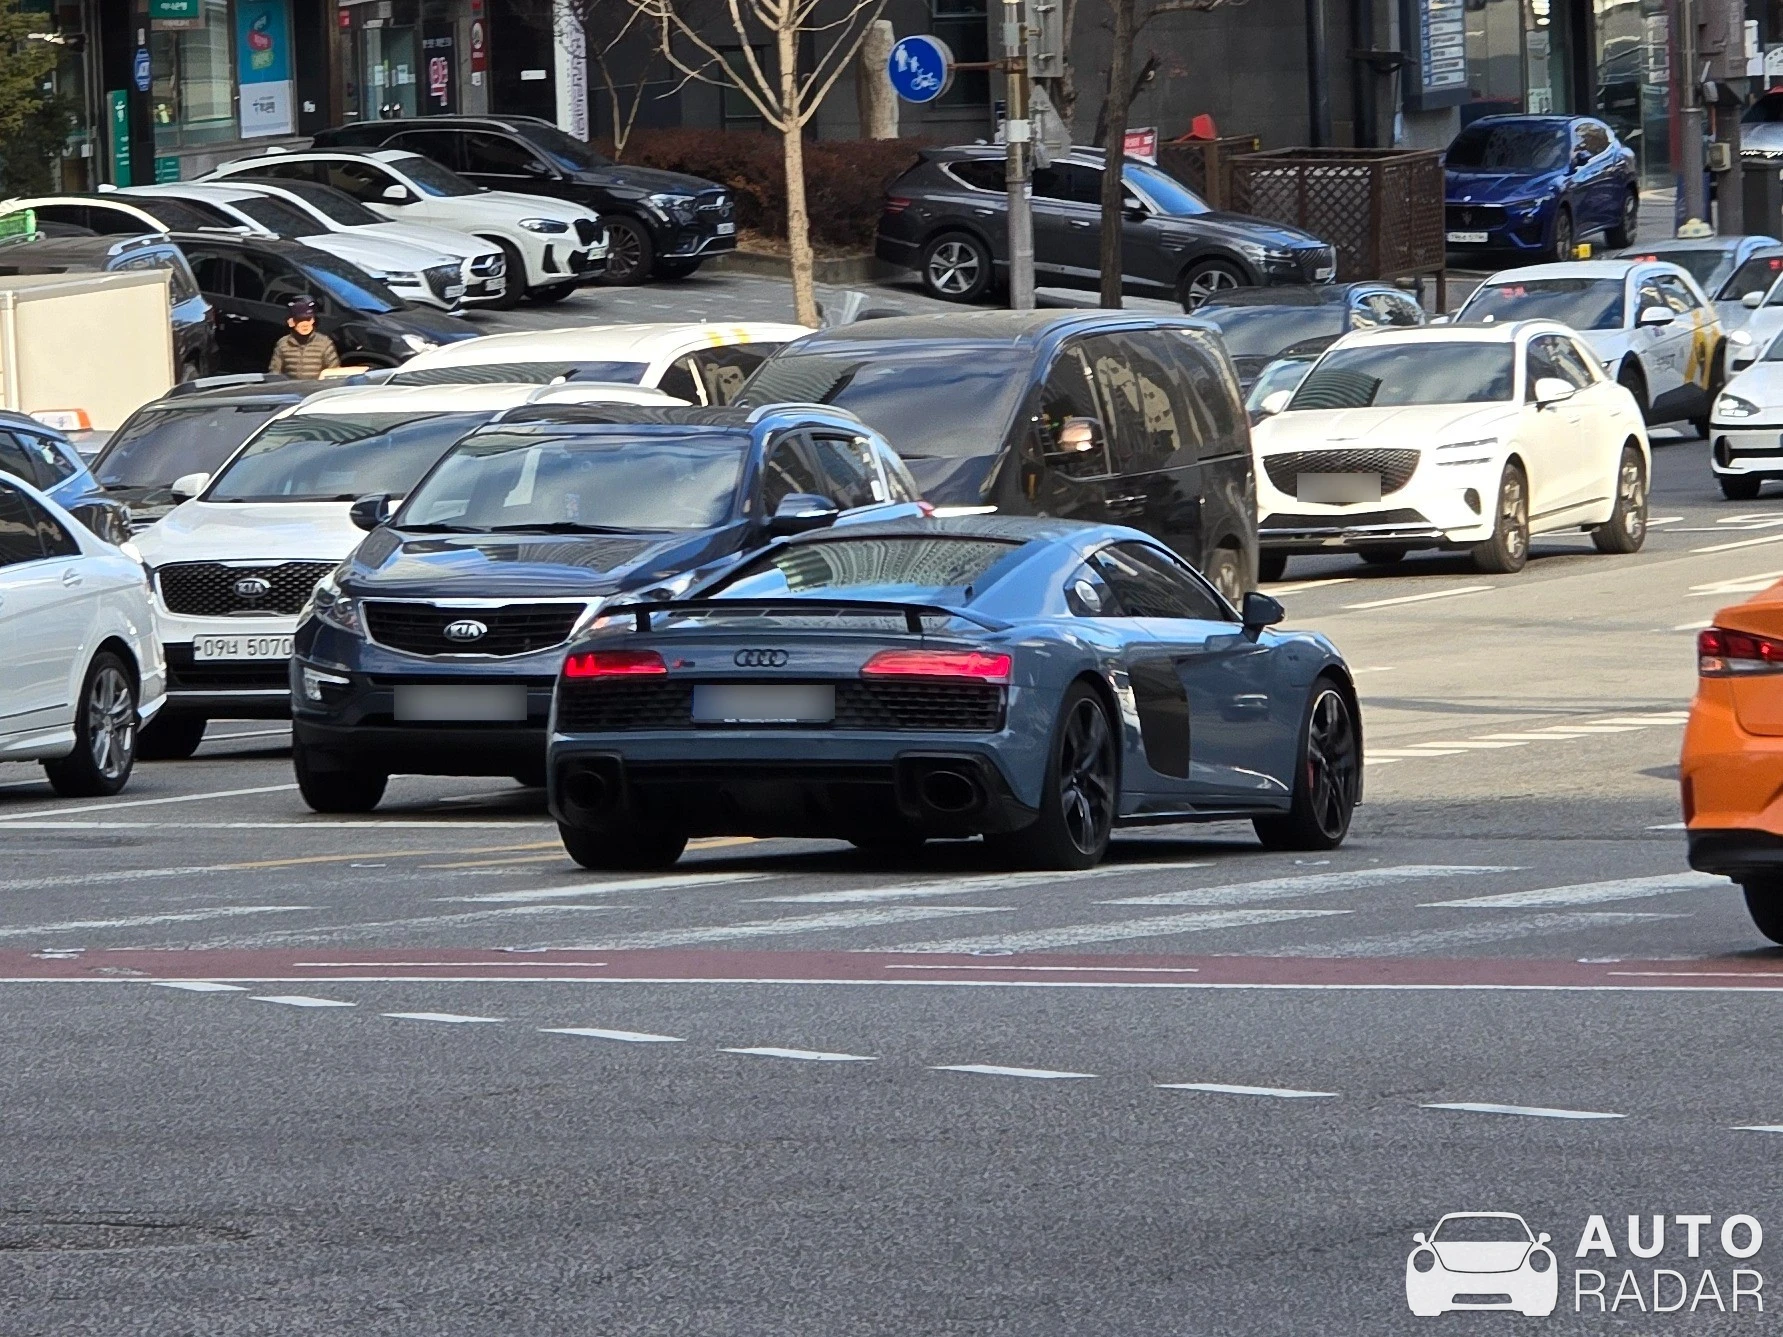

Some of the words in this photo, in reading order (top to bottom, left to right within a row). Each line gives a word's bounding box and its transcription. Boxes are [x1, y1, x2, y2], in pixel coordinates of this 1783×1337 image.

[237, 581, 264, 594] KIA
[449, 623, 480, 638] KIA
[246, 638, 293, 656] 5070
